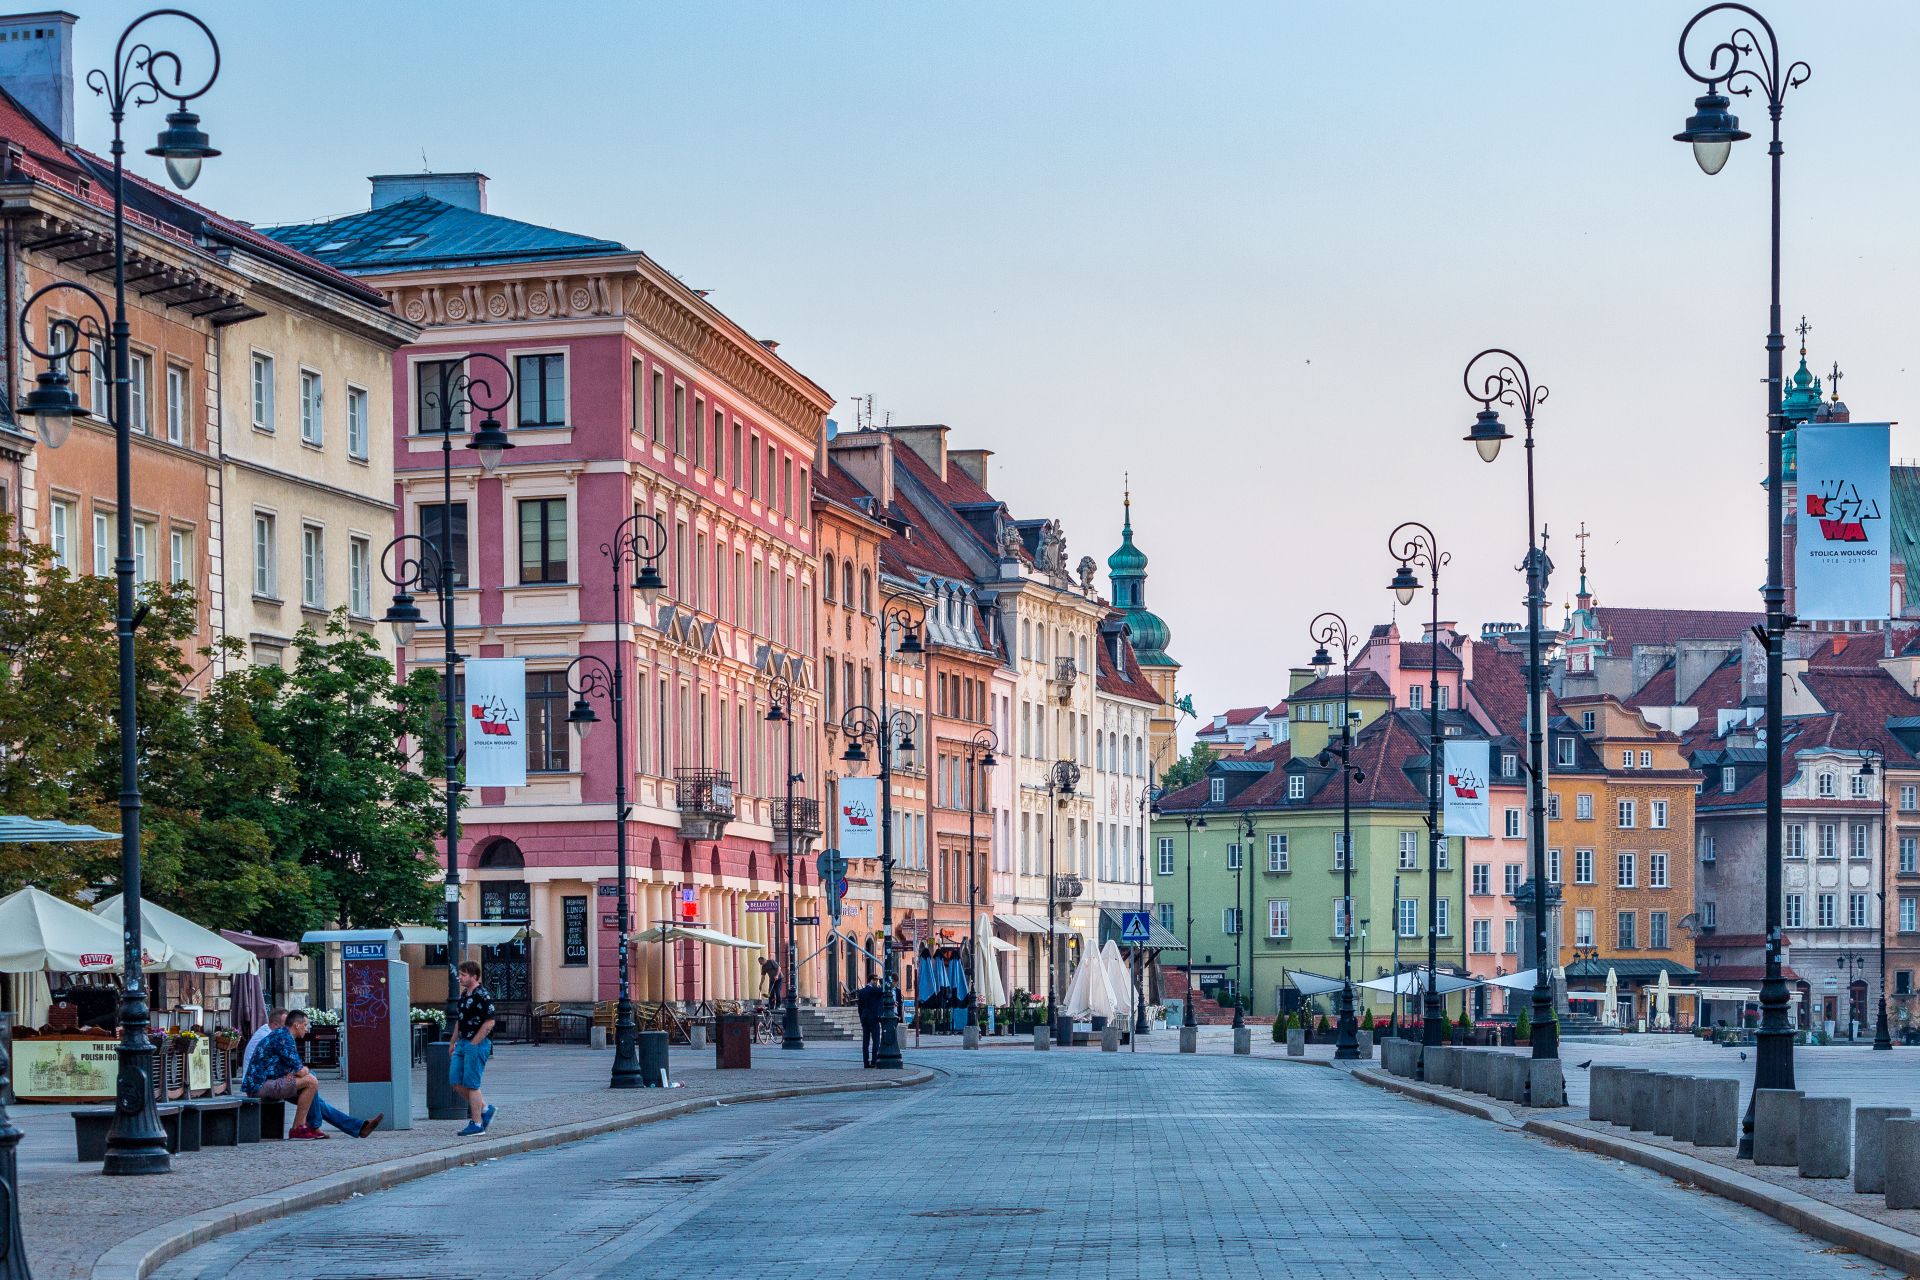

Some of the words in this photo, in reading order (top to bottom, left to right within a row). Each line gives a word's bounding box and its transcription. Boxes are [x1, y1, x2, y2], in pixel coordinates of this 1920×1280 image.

[1840, 549, 1878, 557] WOLNOŚCI
[566, 906, 586, 914] LUNCH
[345, 945, 383, 954] BILETY
[567, 945, 586, 957] CLUB
[82, 954, 112, 965] ŻYWIEC
[198, 956, 221, 967] ŻYWIEC
[92, 1043, 104, 1051] THE
[81, 1053, 104, 1061] POLISH
